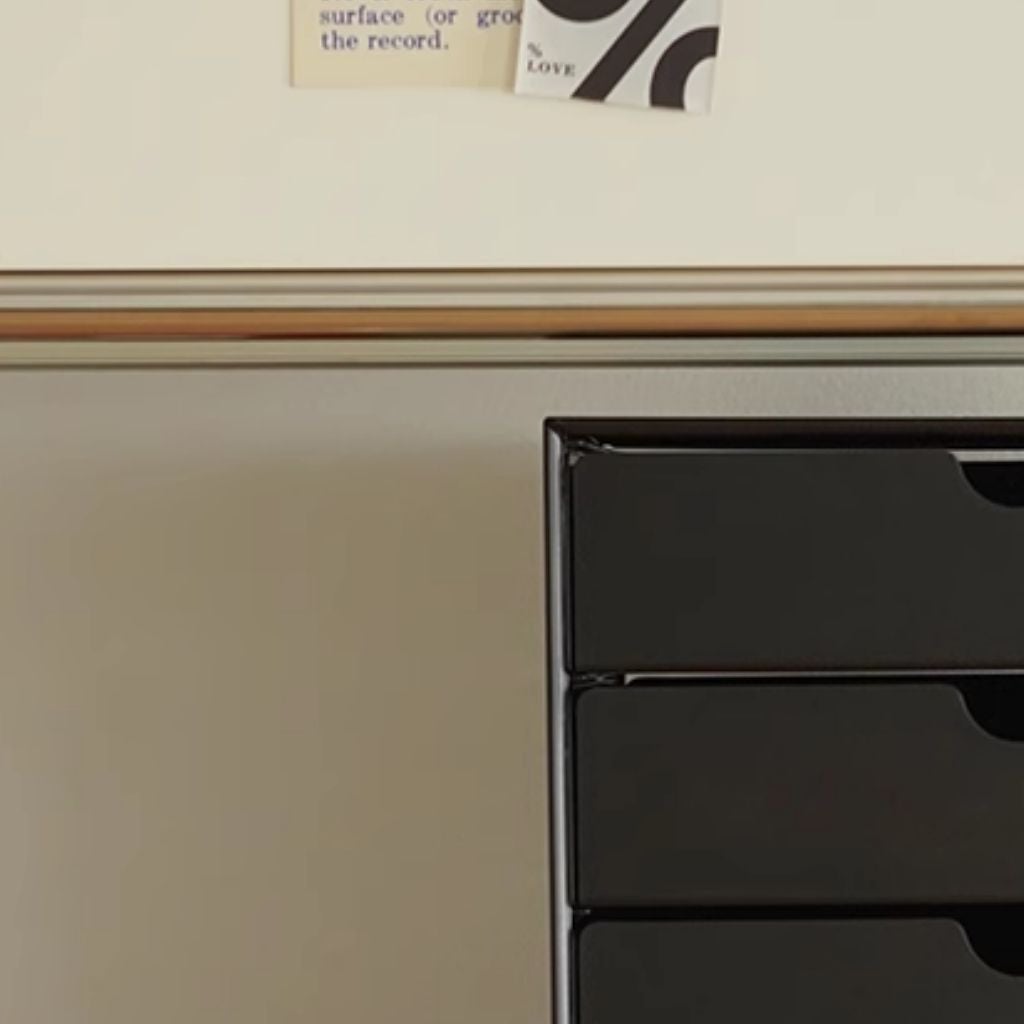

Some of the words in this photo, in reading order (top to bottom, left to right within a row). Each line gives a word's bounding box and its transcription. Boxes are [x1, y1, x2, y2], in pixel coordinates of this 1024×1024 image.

[319, 5, 404, 26] surface
[425, 6, 458, 26] (or
[320, 30, 358, 50] the
[367, 30, 449, 50] record.
[526, 59, 576, 77] LOVE
